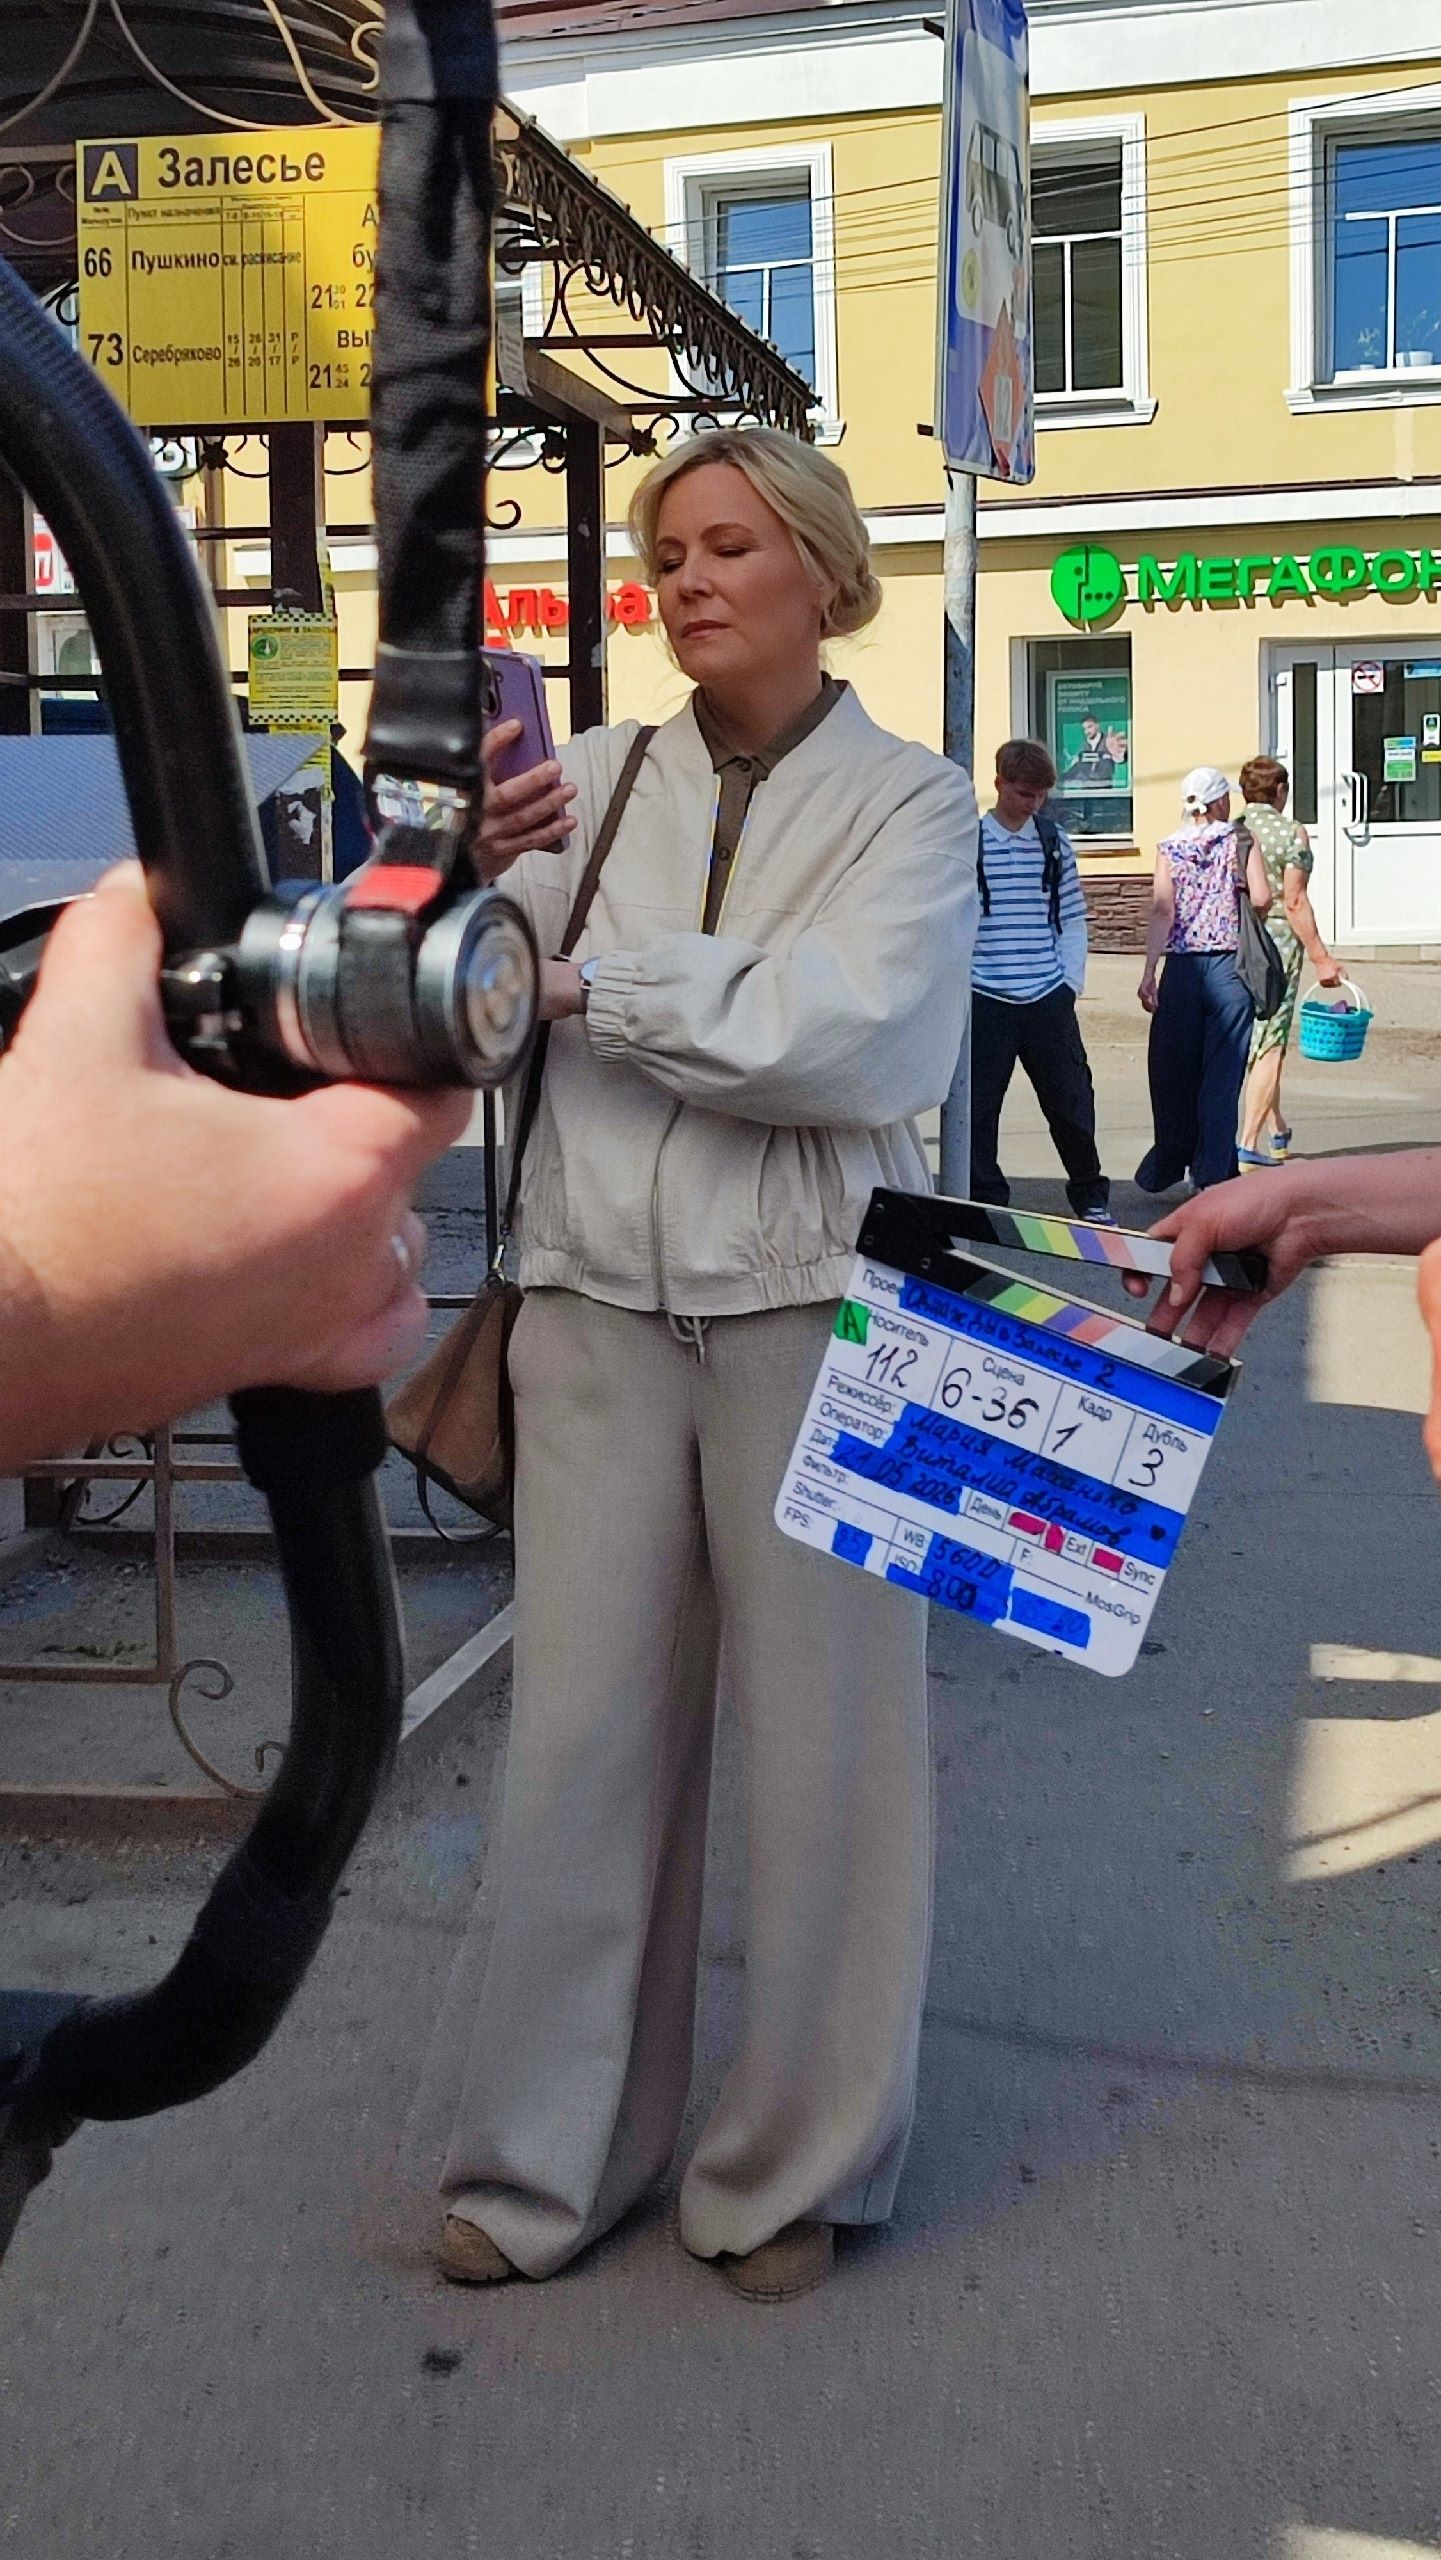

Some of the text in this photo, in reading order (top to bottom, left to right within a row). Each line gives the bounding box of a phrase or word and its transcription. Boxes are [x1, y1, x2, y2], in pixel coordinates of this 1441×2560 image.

[91, 147, 325, 196] А Залесье
[128, 206, 158, 221] Пункт
[84, 247, 112, 278] 66
[131, 249, 220, 275] Пушкино
[353, 243, 375, 274] бу
[87, 332, 222, 367] 73 Серебряково
[337, 330, 373, 348] вы
[309, 364, 331, 389] 21
[483, 577, 650, 628] Альа
[862, 1268, 901, 1294] Прое
[865, 1343, 918, 1388] 112
[982, 1356, 1026, 1387] Сцена
[1094, 1361, 1116, 1389] 2
[942, 1367, 1040, 1429] 6-36
[1078, 1396, 1113, 1422] Кадр
[909, 1411, 996, 1457] Мария
[1052, 1422, 1083, 1453] 1
[1142, 1422, 1188, 1453] Дубль
[1128, 1448, 1164, 1487] 3
[932, 1536, 1002, 1580] 5600
[1065, 1535, 1087, 1555] Ext
[1124, 1561, 1156, 1586] Sync
[1085, 1590, 1141, 1627] MosGrip
